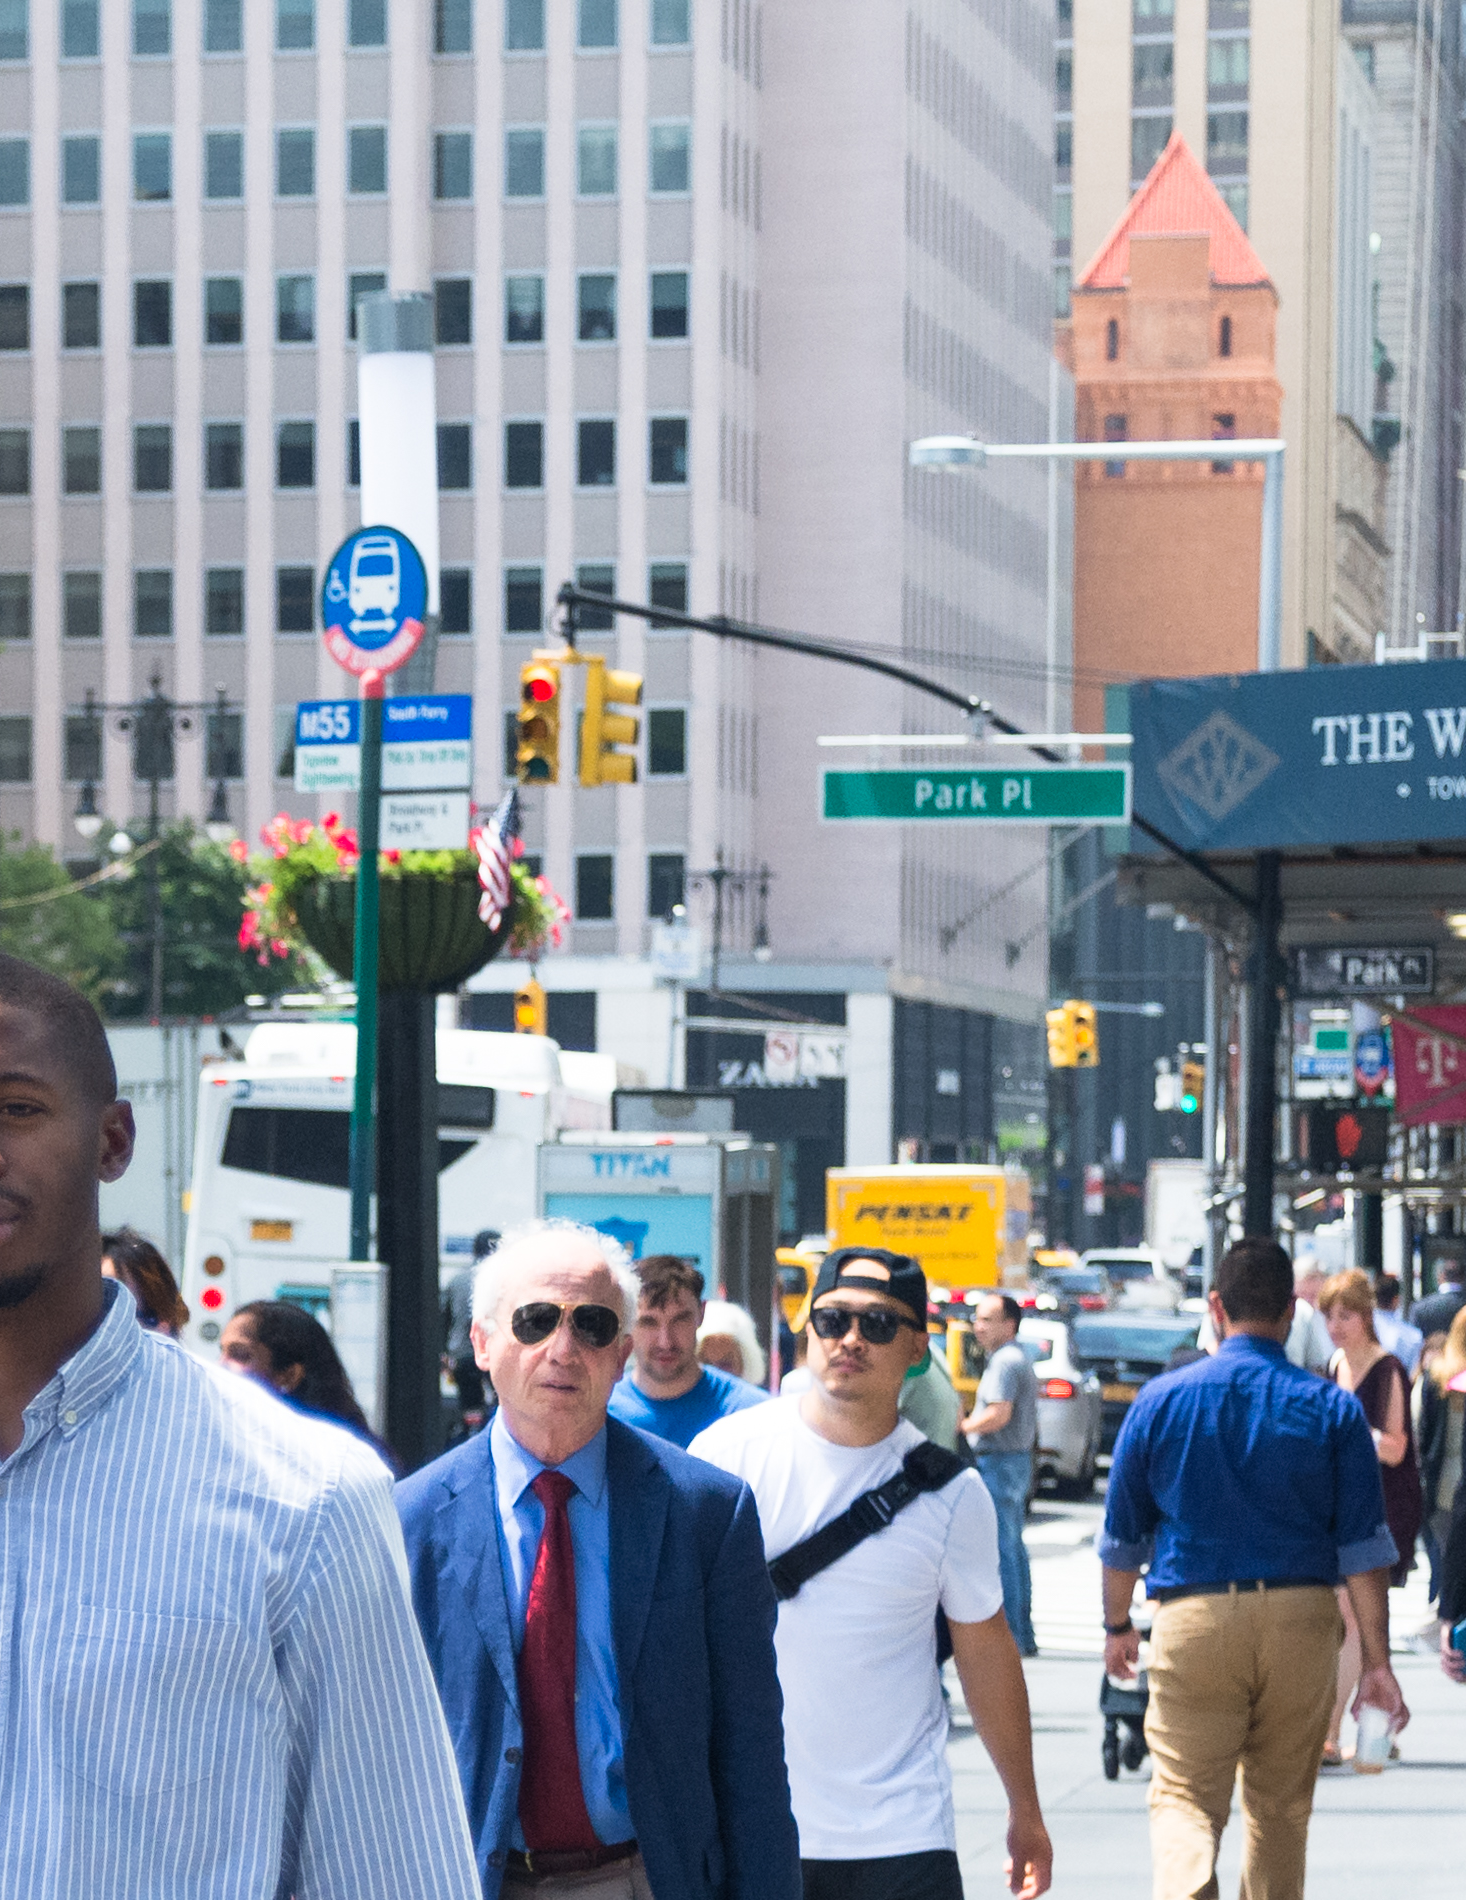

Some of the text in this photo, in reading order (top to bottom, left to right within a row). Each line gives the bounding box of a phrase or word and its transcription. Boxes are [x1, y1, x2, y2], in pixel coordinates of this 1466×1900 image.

[300, 705, 350, 740] M55
[1312, 711, 1414, 765] THE
[916, 777, 1033, 810] Park Pl
[718, 1060, 819, 1089] ZA
[590, 1153, 671, 1178] TITAN
